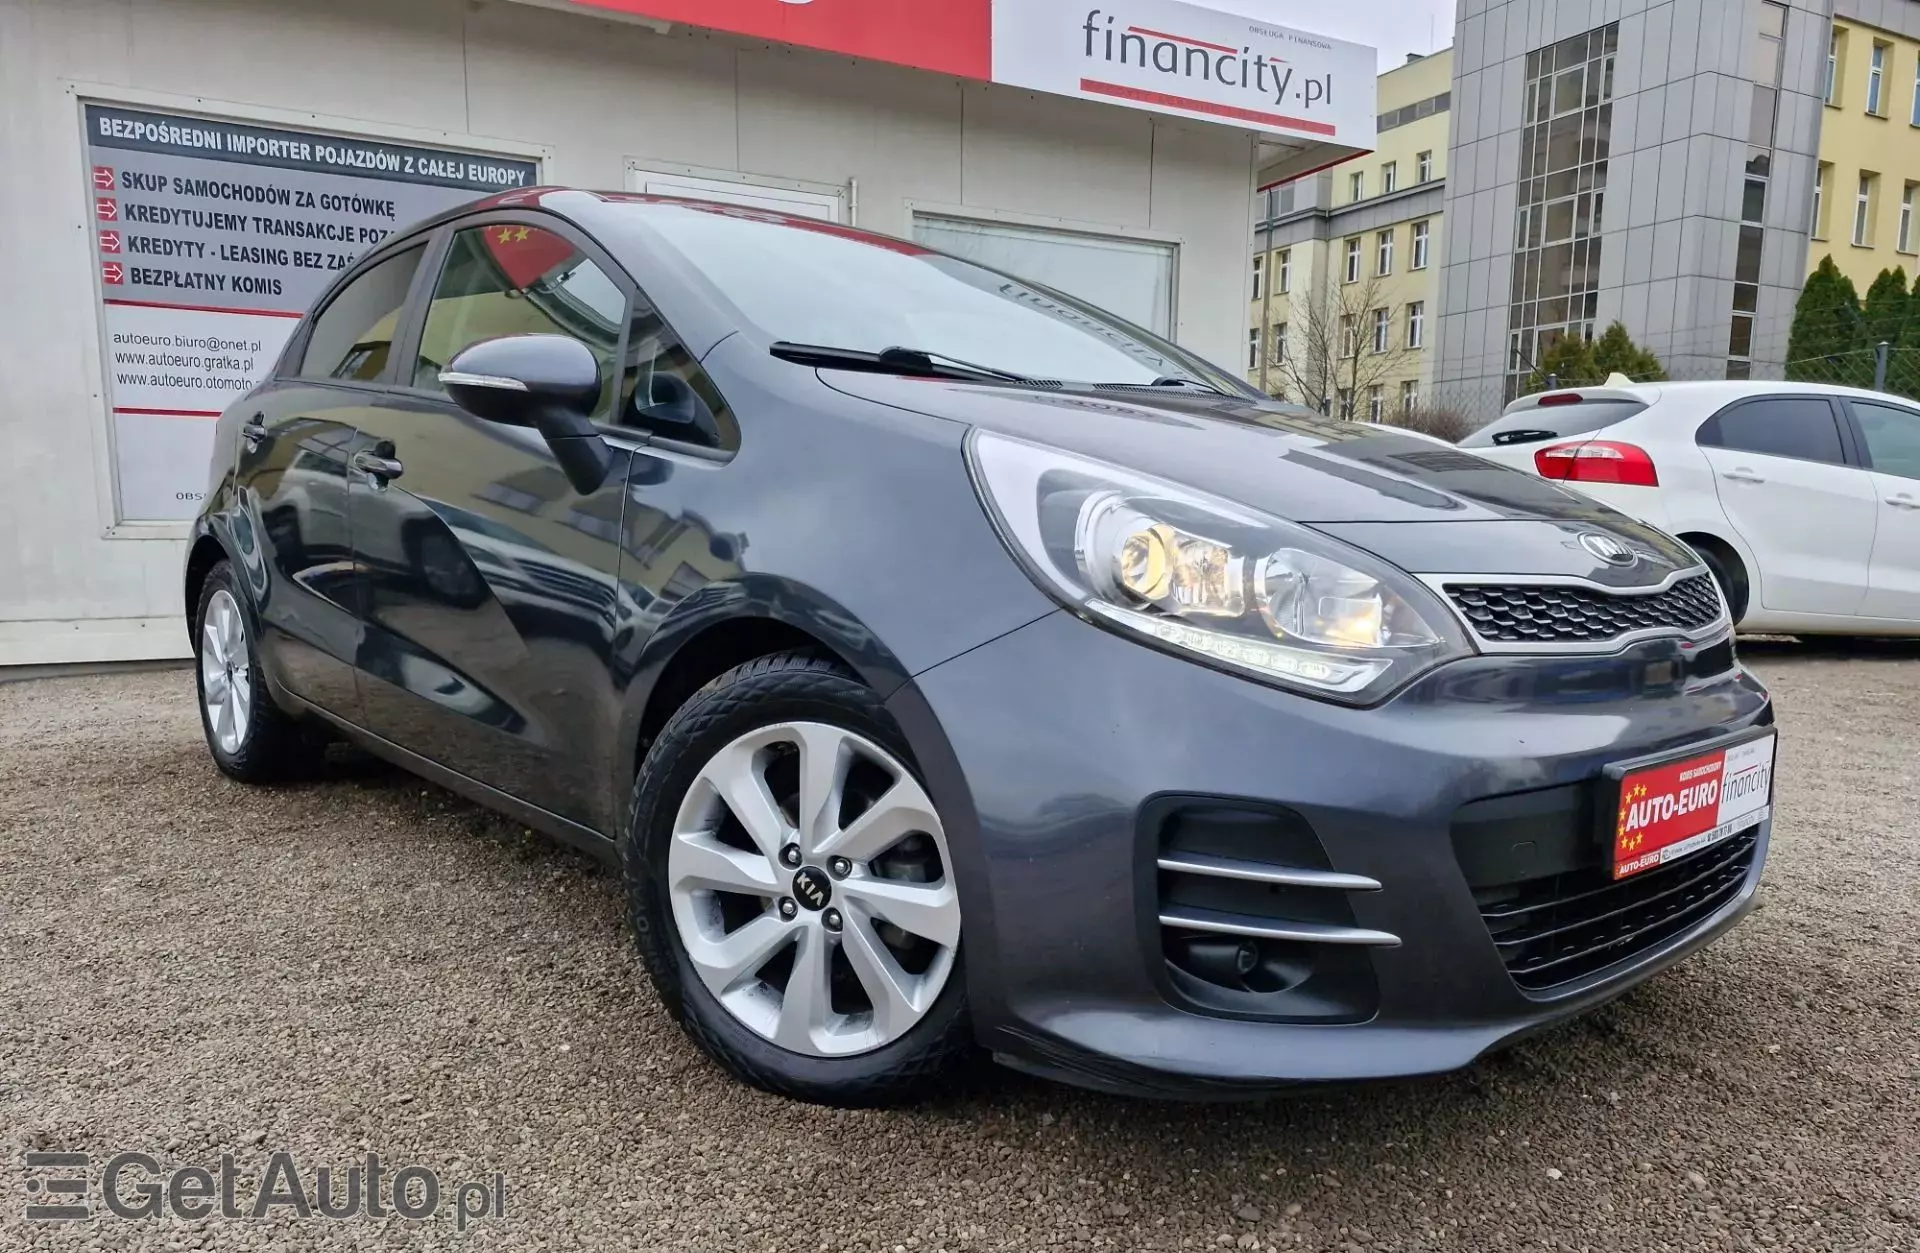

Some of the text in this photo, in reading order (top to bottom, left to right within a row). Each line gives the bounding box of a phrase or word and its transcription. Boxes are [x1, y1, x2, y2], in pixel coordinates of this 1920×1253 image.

[1083, 10, 1331, 108] financity.pl
[100, 117, 525, 186] BEZPOŚREDNI IMPORTER POJAZDÓW Z CAŁEJ EUROPY
[121, 171, 395, 221] SKUP SAMOCHODÓW ZA GOTÓWKĘ
[125, 203, 395, 244] KREDYTUJEMY TRANSAKCJE POZ
[128, 235, 205, 259] KREDYTY
[220, 244, 289, 266] LEASING
[293, 251, 323, 270] BEZ
[131, 267, 282, 295] BEZPŁATNY KOMIS
[113, 332, 262, 352] autoeuro.biuro@onet.pl
[115, 352, 254, 373] www.autoeuro.gratka.pl
[176, 492, 207, 501] OBS
[1721, 761, 1771, 804] financity
[1625, 779, 1718, 832] AUTO-EURO
[1619, 853, 1659, 874] AUTO-EURO
[797, 872, 824, 907] KIA
